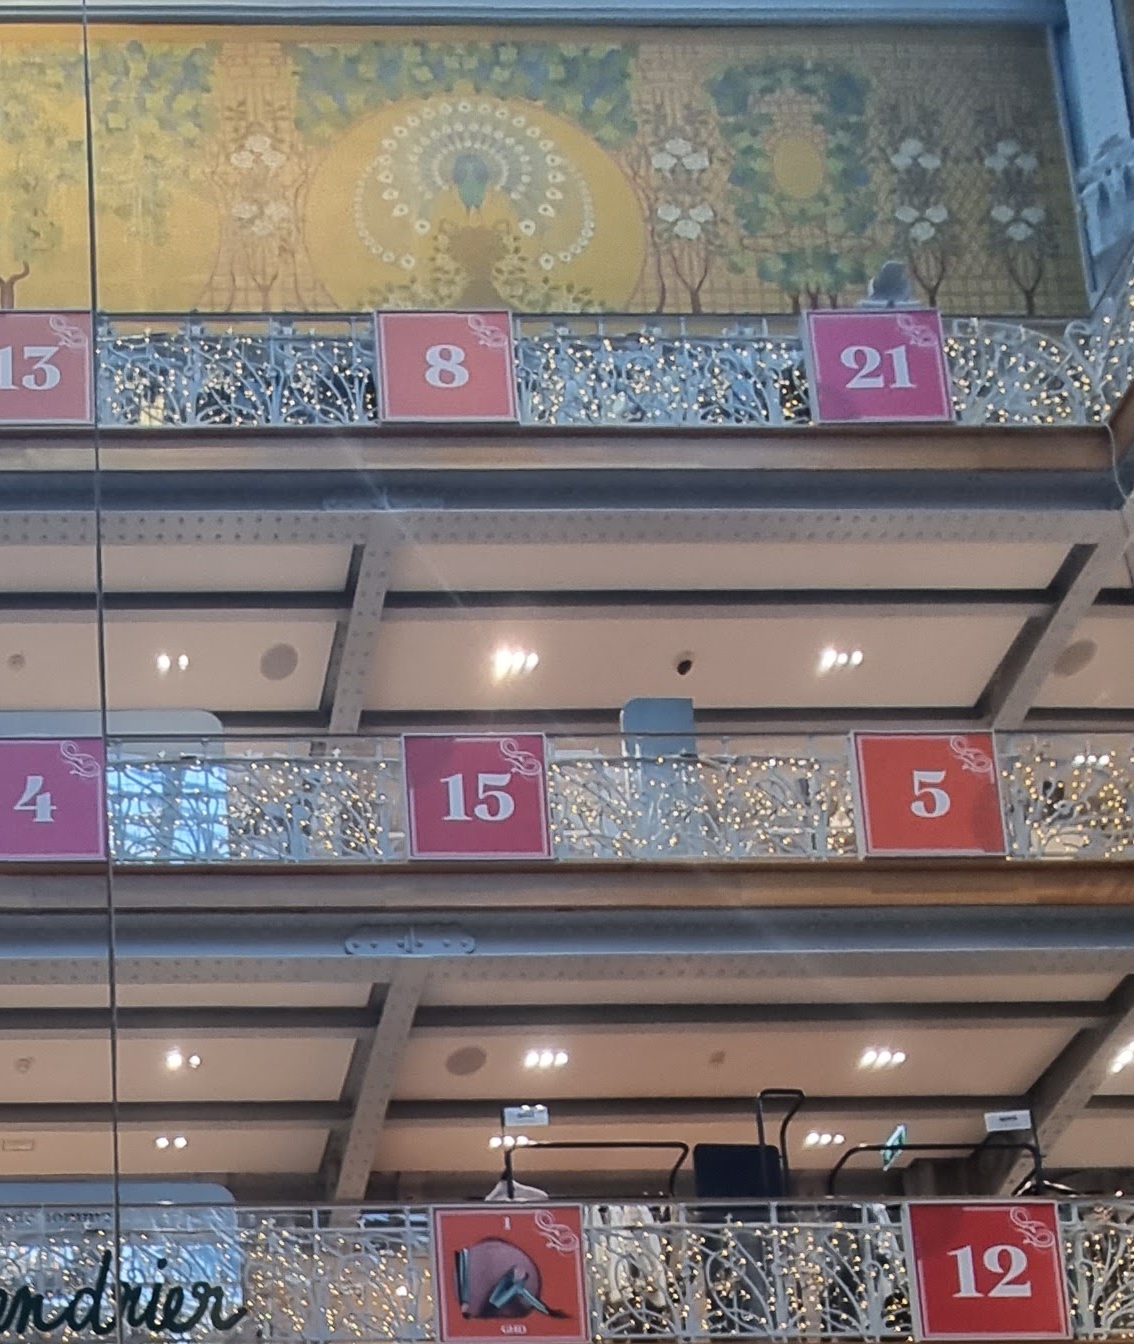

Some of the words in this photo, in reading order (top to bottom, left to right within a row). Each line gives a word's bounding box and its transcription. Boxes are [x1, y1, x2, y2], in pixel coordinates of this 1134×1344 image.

[425, 345, 469, 387] 8
[841, 346, 913, 388] 21
[14, 776, 57, 822] 4
[440, 774, 514, 820] 15
[911, 771, 950, 817] 5
[948, 1245, 1031, 1297] 12
